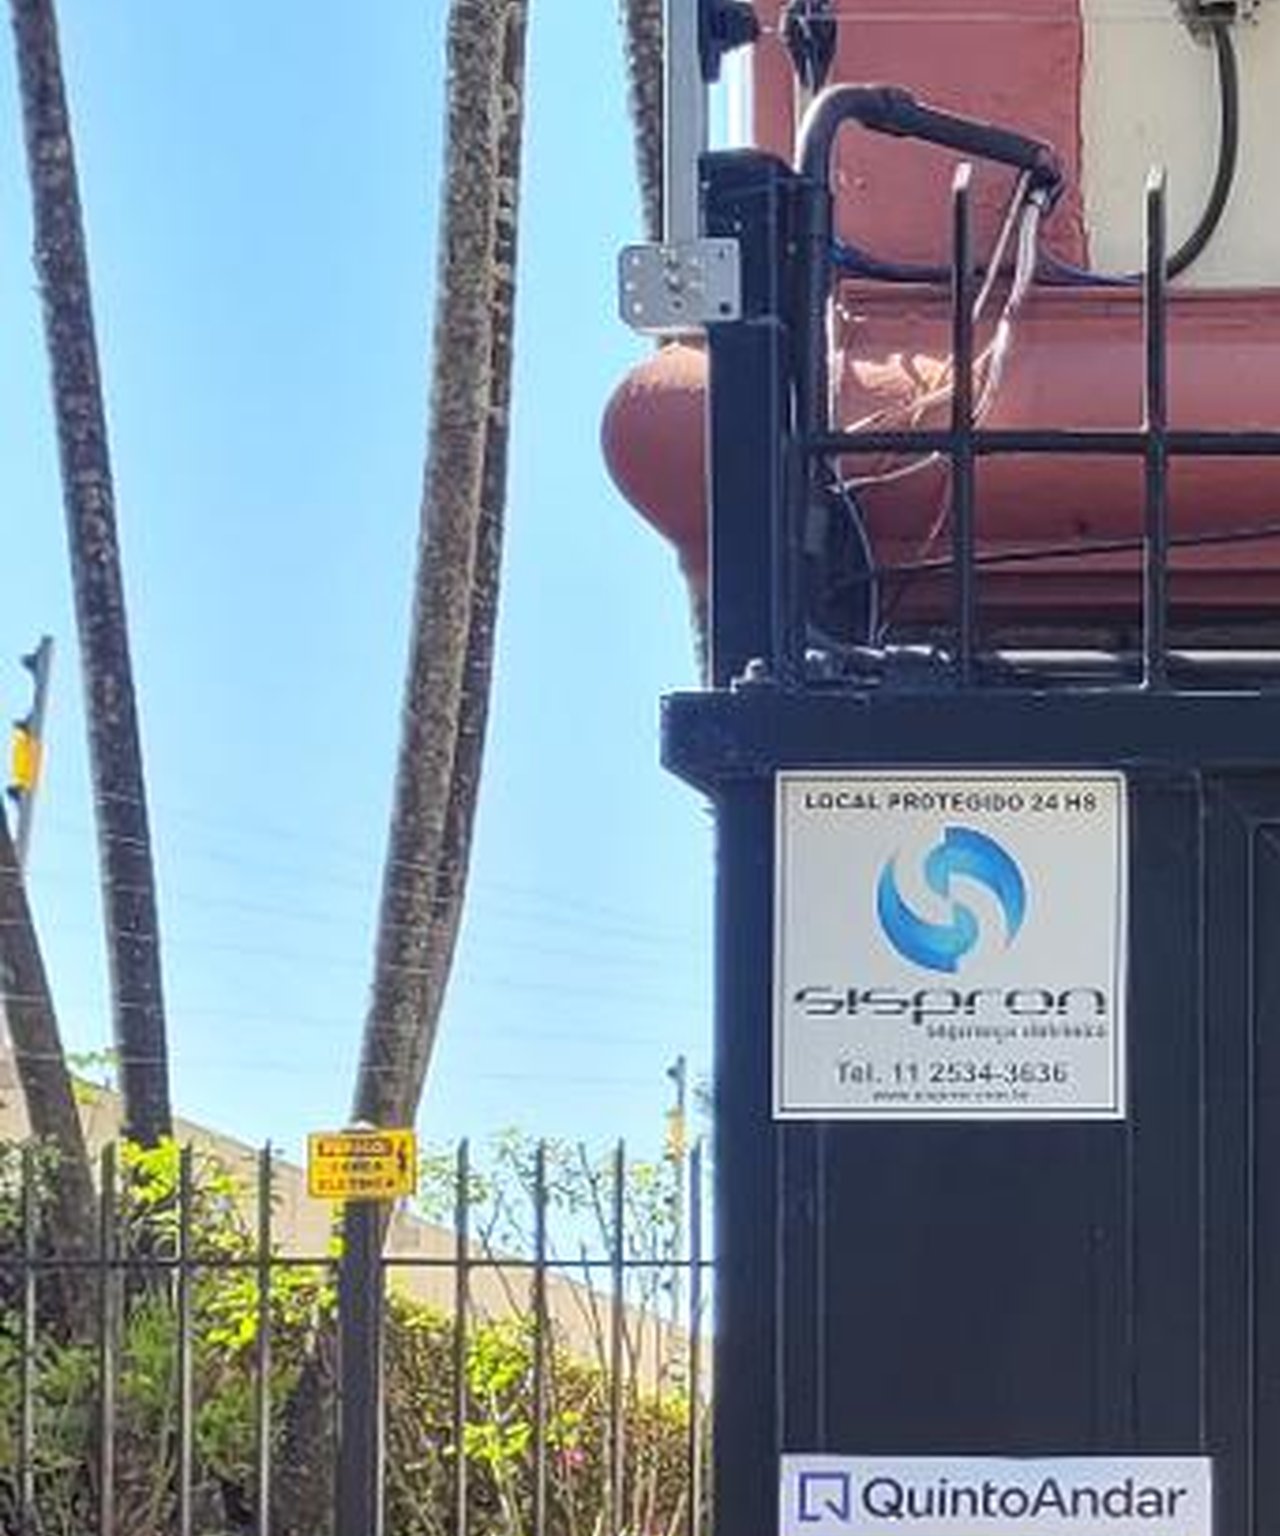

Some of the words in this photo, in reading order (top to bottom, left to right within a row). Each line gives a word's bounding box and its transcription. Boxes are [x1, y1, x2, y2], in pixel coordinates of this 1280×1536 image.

[804, 792, 881, 810] LOCAL
[887, 792, 1024, 811] PROTEGIDO
[1031, 792, 1059, 810] 24
[838, 1063, 882, 1084] Tel.
[893, 1063, 919, 1084] 11
[929, 1063, 1068, 1085] 2534-3636
[862, 1476, 1187, 1520] QuintoAndar
